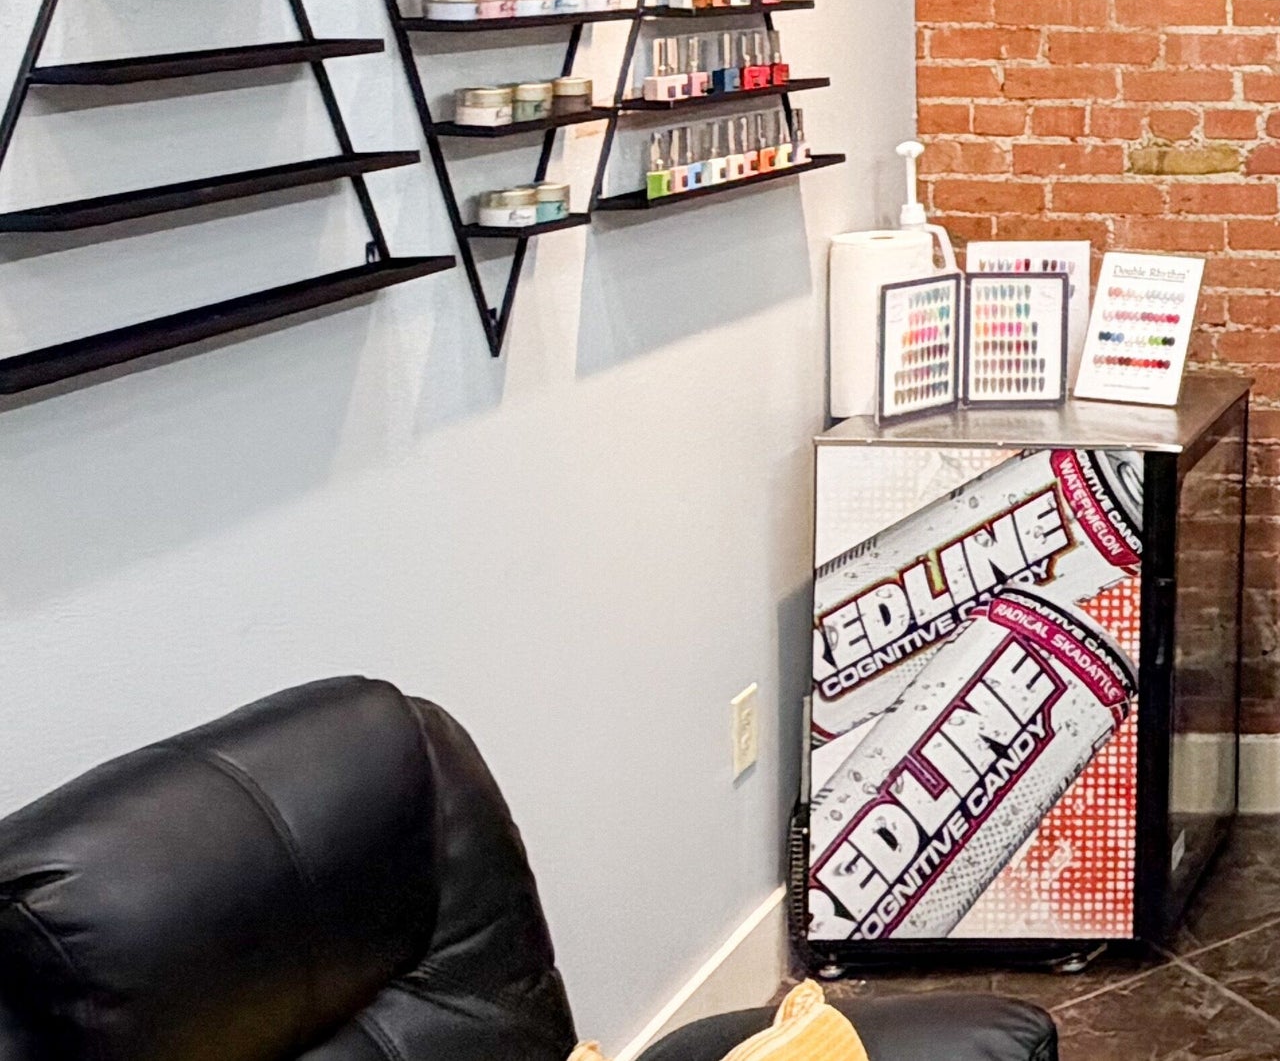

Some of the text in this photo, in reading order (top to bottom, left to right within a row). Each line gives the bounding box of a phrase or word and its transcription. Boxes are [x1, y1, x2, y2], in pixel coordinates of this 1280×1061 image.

[1059, 456, 1125, 556] WATERMELON
[1076, 449, 1115, 512] GNITIVE
[821, 558, 1049, 698] COGNITIVE CDY
[993, 604, 1122, 701] RADICAL SKADATTLE
[966, 712, 1047, 818] CANDY
